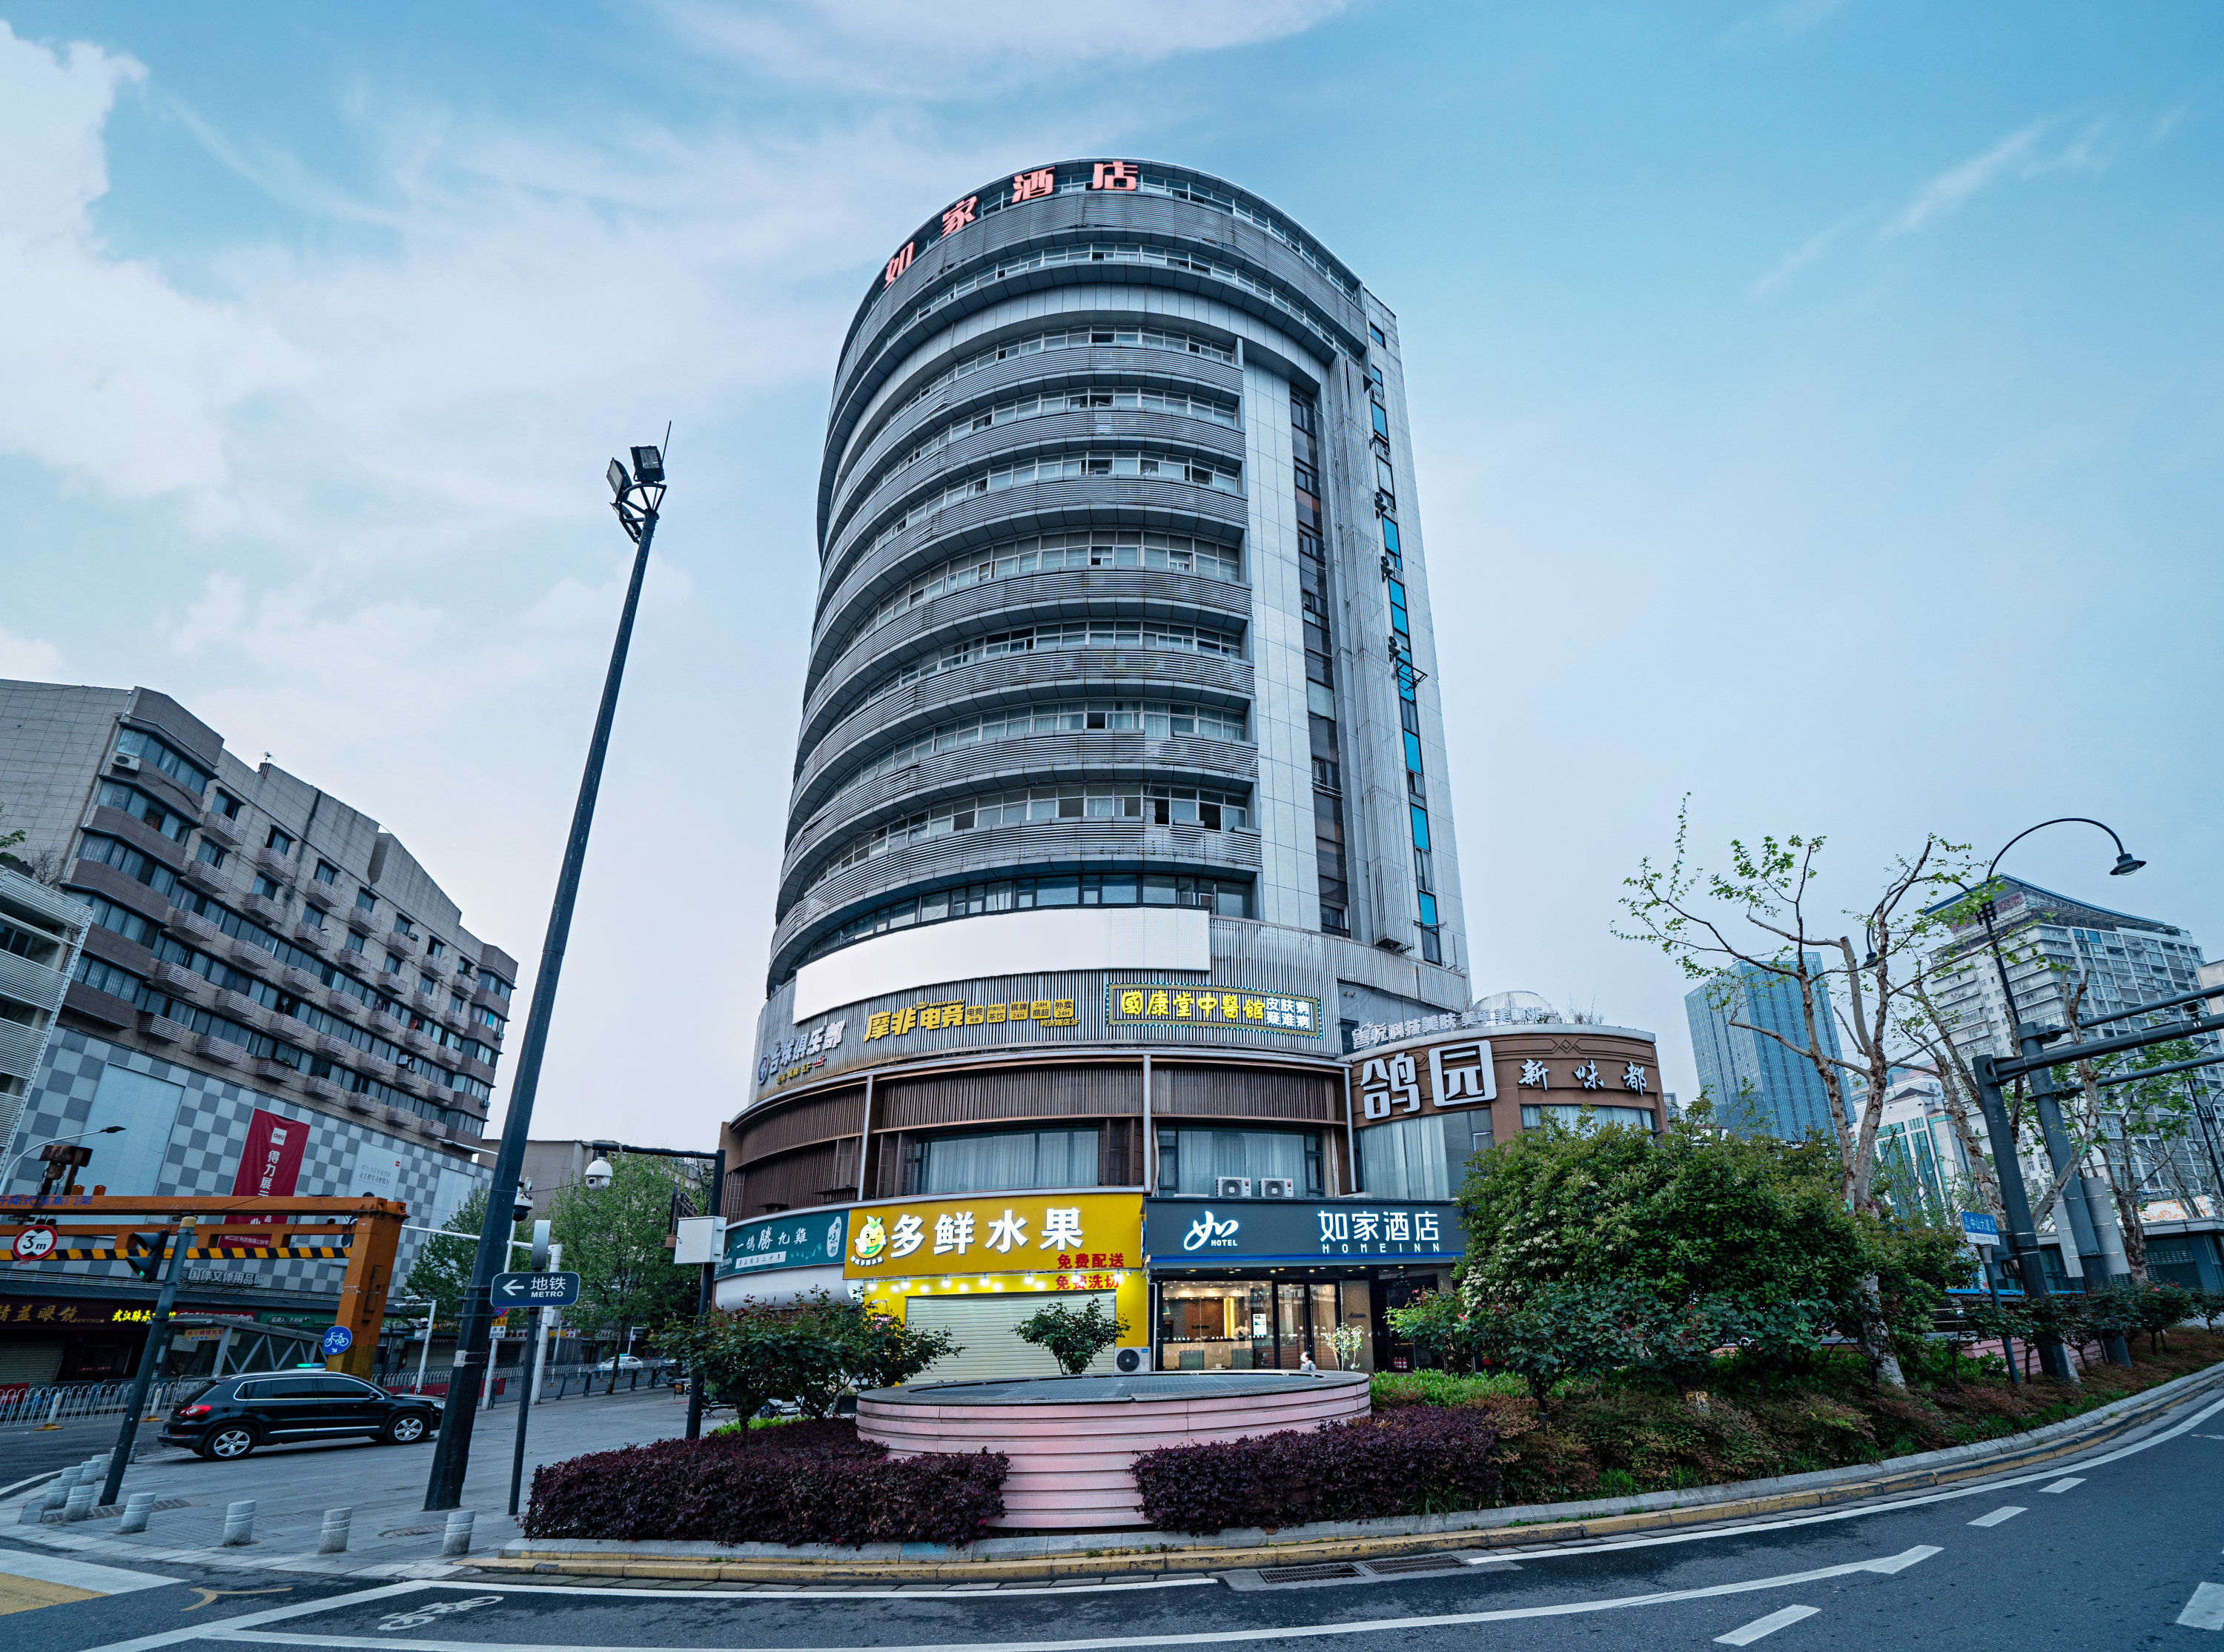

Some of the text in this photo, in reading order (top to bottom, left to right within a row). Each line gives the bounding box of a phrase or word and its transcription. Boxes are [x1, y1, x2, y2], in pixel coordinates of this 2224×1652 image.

[883, 161, 1138, 290] 如家酒店
[967, 1008, 983, 1016] 电竞
[1011, 1004, 1027, 1012] 棋牌
[1055, 1001, 1072, 1009] 外卖
[1121, 990, 1265, 1020] 國康堂中醫館
[1266, 998, 1310, 1015] 皮肤病
[864, 1004, 964, 1042] 摩非电竞
[988, 1012, 1005, 1021] 茶饮
[1266, 1012, 1310, 1028] 疑难病
[1360, 1039, 1497, 1120] 鸽园
[1518, 1058, 1647, 1096] 新味都
[890, 1207, 1084, 1258] 多鲜水果
[1317, 1210, 1439, 1242] 如家酒店
[1970, 1216, 1991, 1232] 中山大道
[1057, 1253, 1125, 1270] 免费配送
[530, 1276, 566, 1290] 地铁
[1056, 1274, 1119, 1290] 免费洗切
